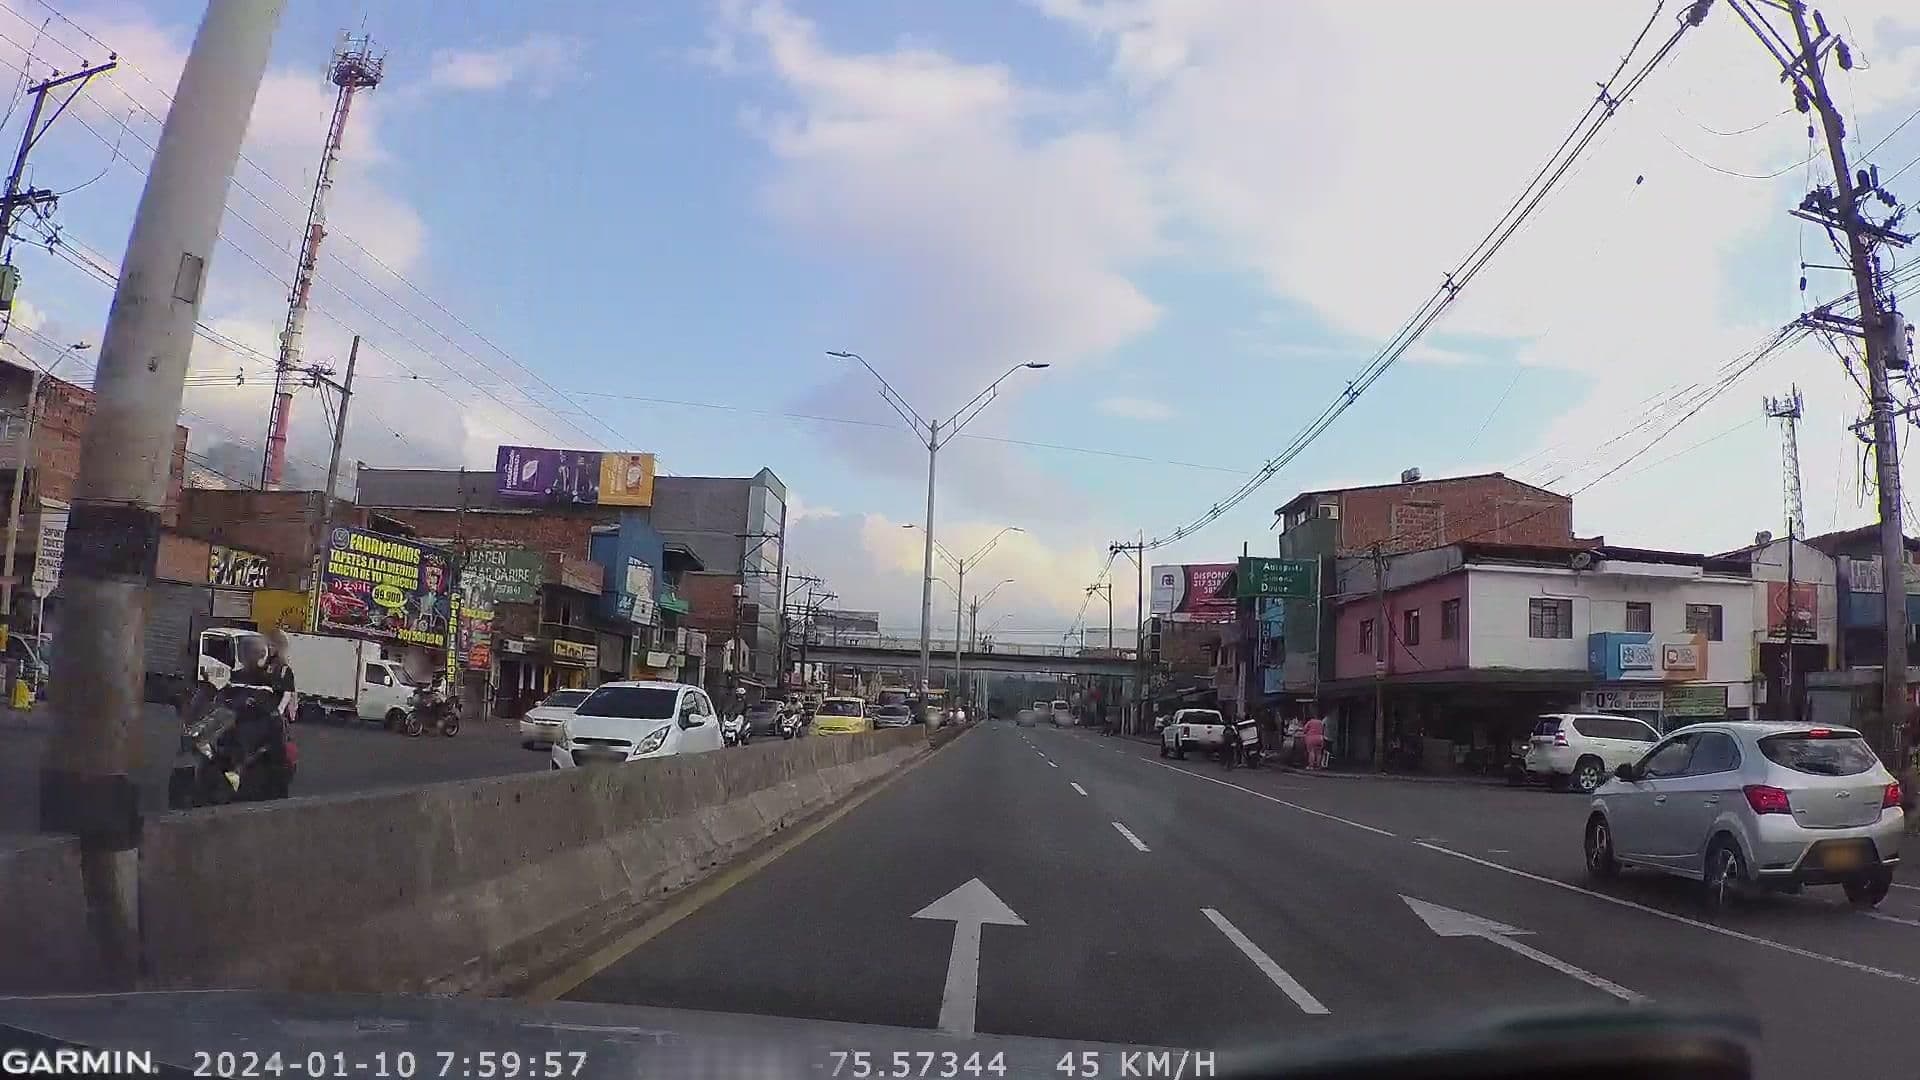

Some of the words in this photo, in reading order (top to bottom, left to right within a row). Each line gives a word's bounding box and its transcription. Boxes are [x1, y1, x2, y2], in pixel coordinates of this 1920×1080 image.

[350, 533, 421, 564] FABRICAMOS
[328, 562, 359, 578] EXACTA
[329, 549, 367, 568] TAPETES
[368, 557, 375, 569] A
[387, 561, 419, 578] MEDIDA
